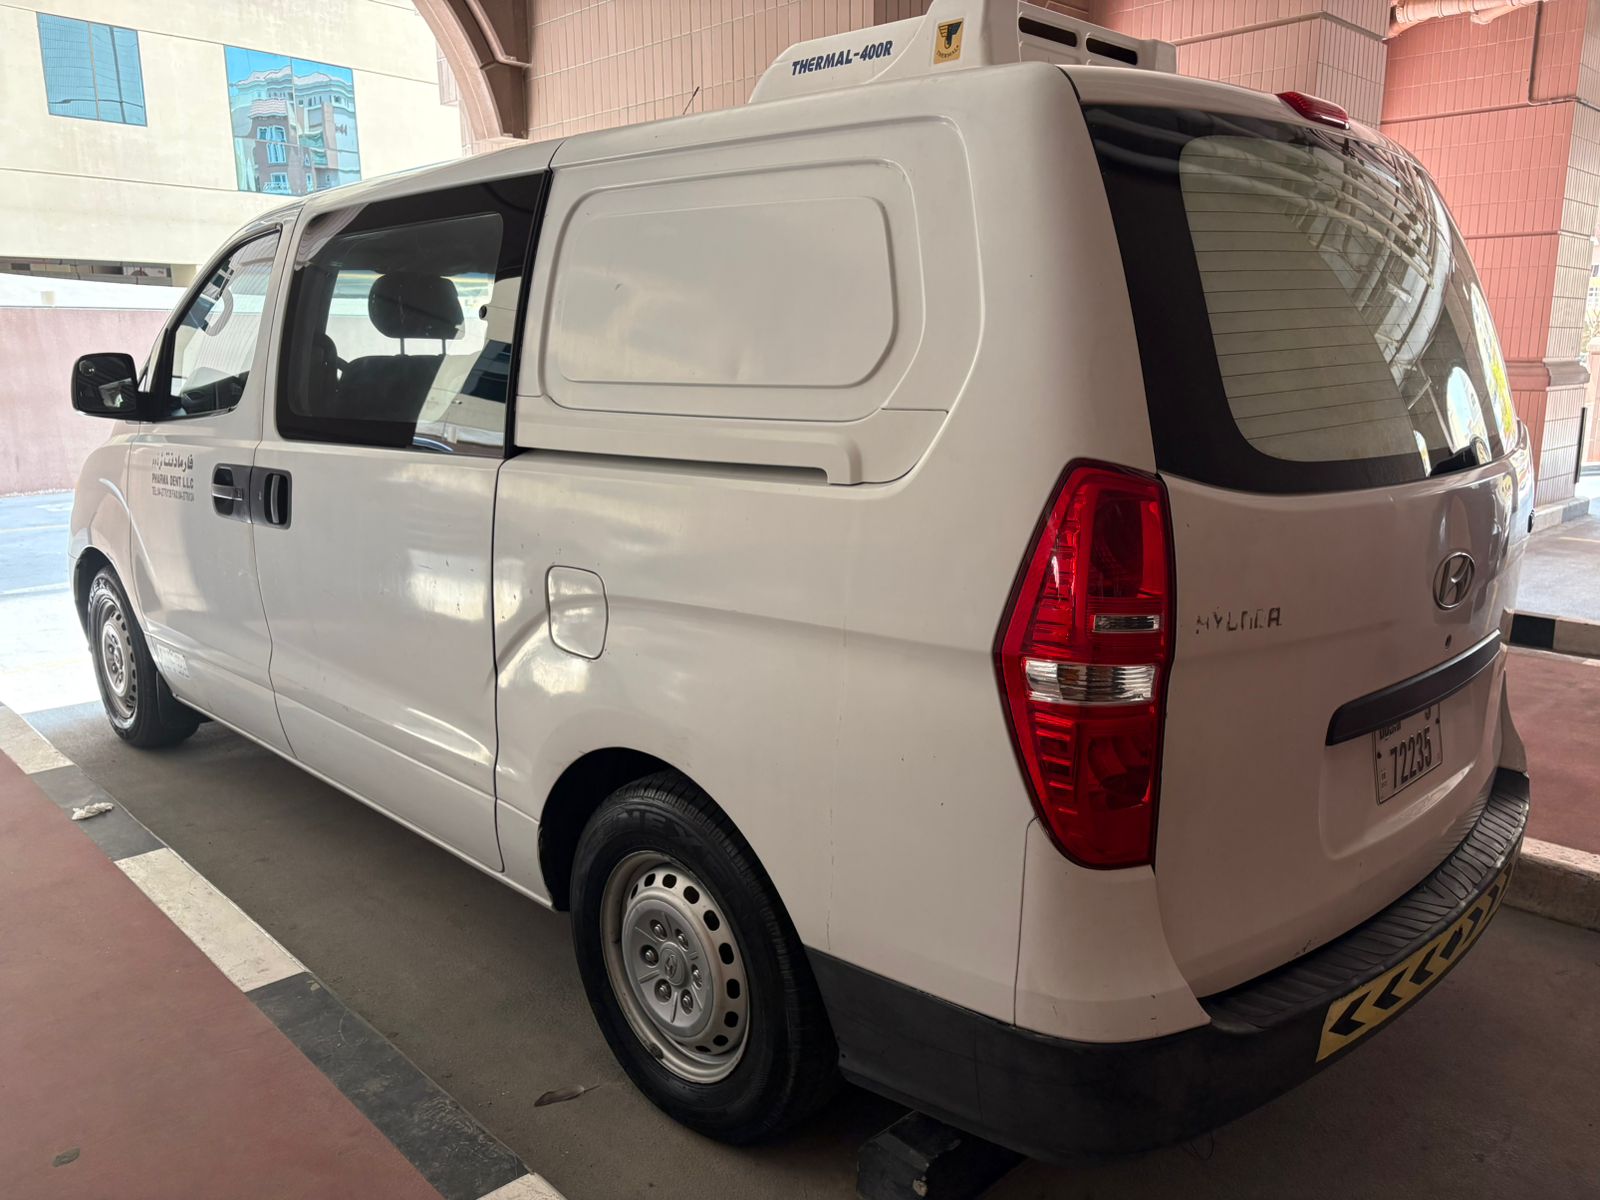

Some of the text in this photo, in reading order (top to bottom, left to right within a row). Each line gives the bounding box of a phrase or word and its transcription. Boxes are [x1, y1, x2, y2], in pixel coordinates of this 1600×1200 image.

[791, 40, 893, 76] THERMAL-400R
[151, 472, 169, 485] PHARMA
[170, 475, 182, 488] DENT
[1390, 725, 1432, 789] 72235
